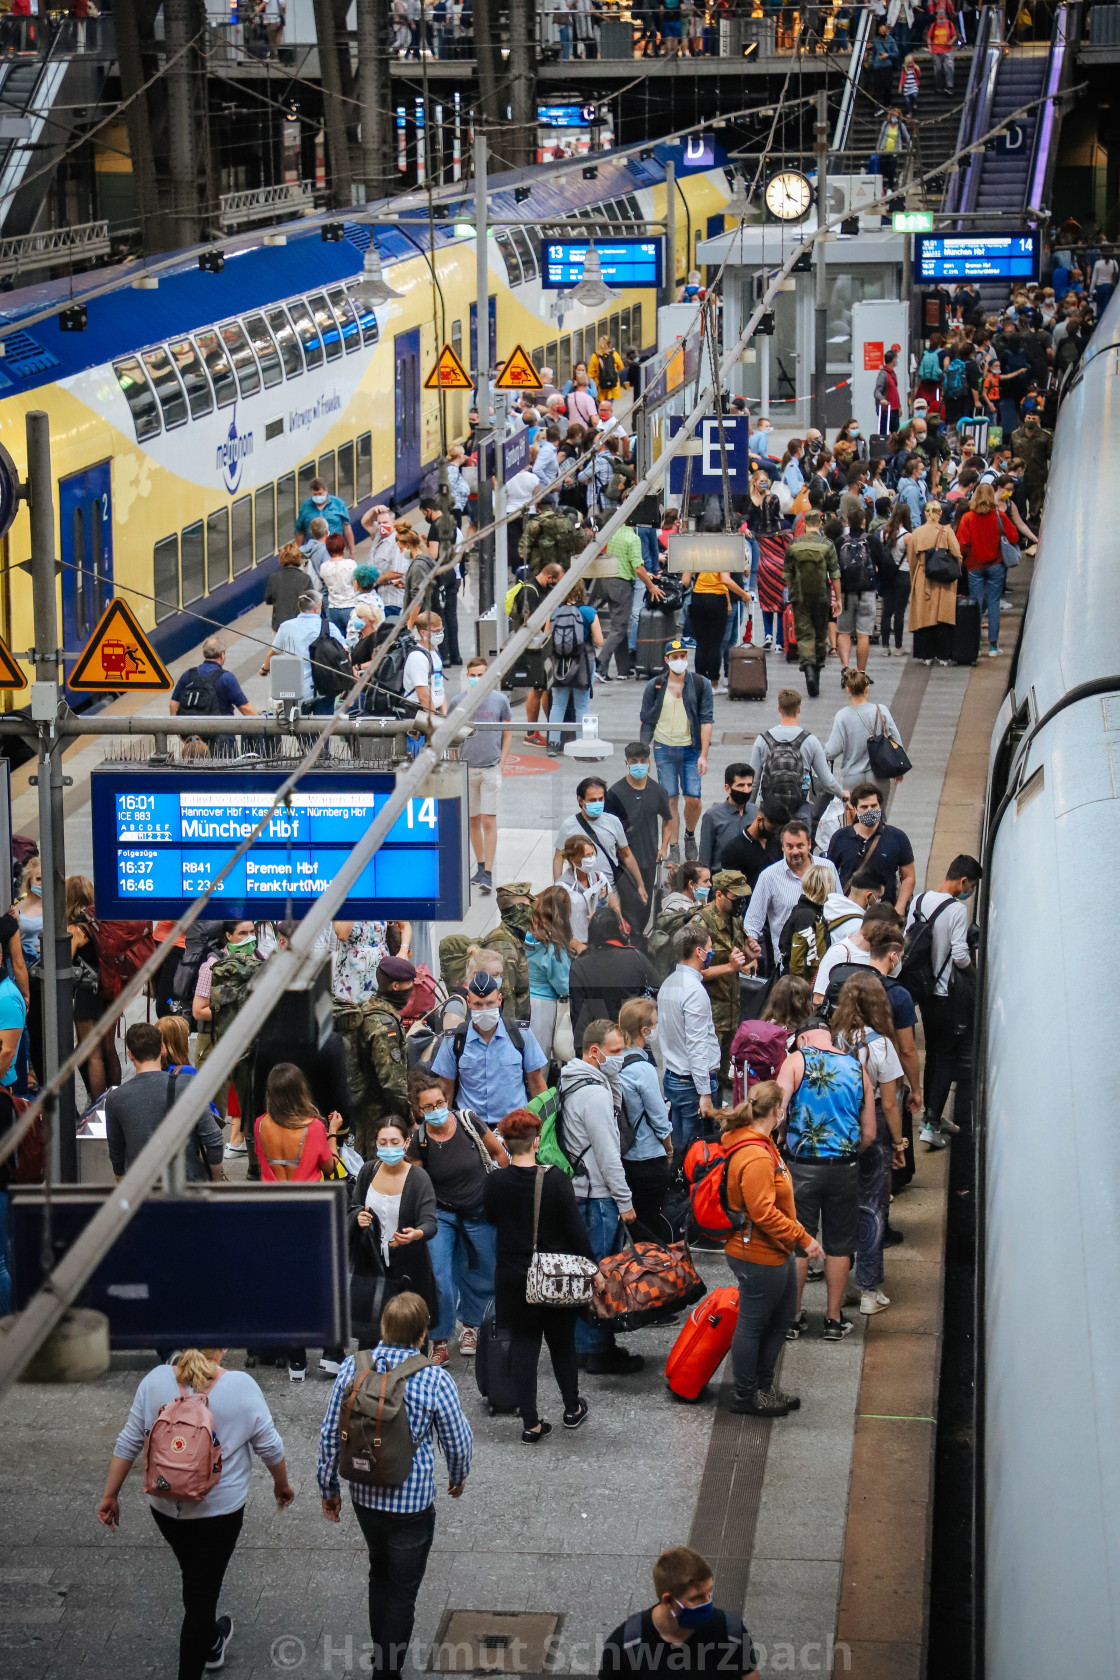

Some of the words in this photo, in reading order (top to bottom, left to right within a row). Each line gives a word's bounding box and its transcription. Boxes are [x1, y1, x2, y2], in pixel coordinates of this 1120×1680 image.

[583, 106, 595, 120] C
[1006, 126, 1022, 148] D
[687, 135, 705, 158] D
[1019, 238, 1033, 252] 14
[549, 246, 563, 259] 13
[702, 419, 737, 476] E
[102, 493, 108, 521] 2
[118, 795, 155, 810] 16:01
[118, 811, 132, 821] ICE
[134, 811, 151, 821] 883
[181, 807, 224, 817] Hannover
[226, 807, 242, 817] Hbf
[251, 807, 298, 817] Kasel-W.
[306, 807, 349, 819] Nürnberg
[350, 807, 367, 817] Hbf
[405, 797, 438, 829] 14
[269, 819, 300, 838] Hbf
[118, 849, 158, 858] Folgezüge
[119, 861, 153, 874] 16:37
[182, 862, 211, 873] RB41
[246, 862, 292, 874] Bremen
[296, 862, 318, 874] Hbf
[119, 879, 154, 891] 16:46
[183, 880, 193, 891] IC
[197, 880, 225, 891] 235
[246, 879, 332, 892] Frankfurt(M)H
